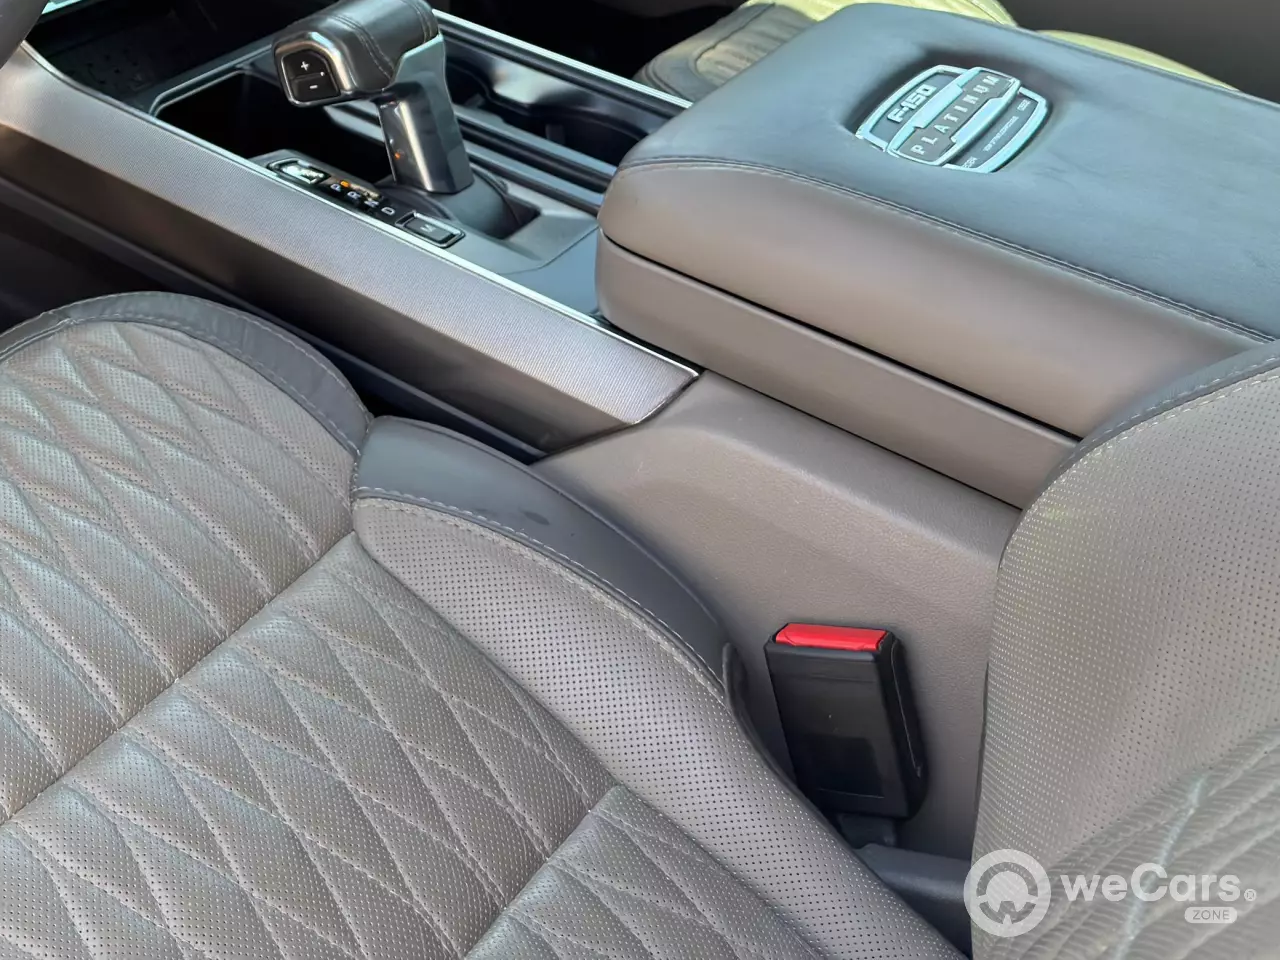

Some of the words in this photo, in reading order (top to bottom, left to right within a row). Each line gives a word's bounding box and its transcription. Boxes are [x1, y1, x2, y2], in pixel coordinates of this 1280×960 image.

[887, 83, 938, 123] F-150
[910, 75, 1001, 156] PLATINUM
[381, 207, 395, 215] D
